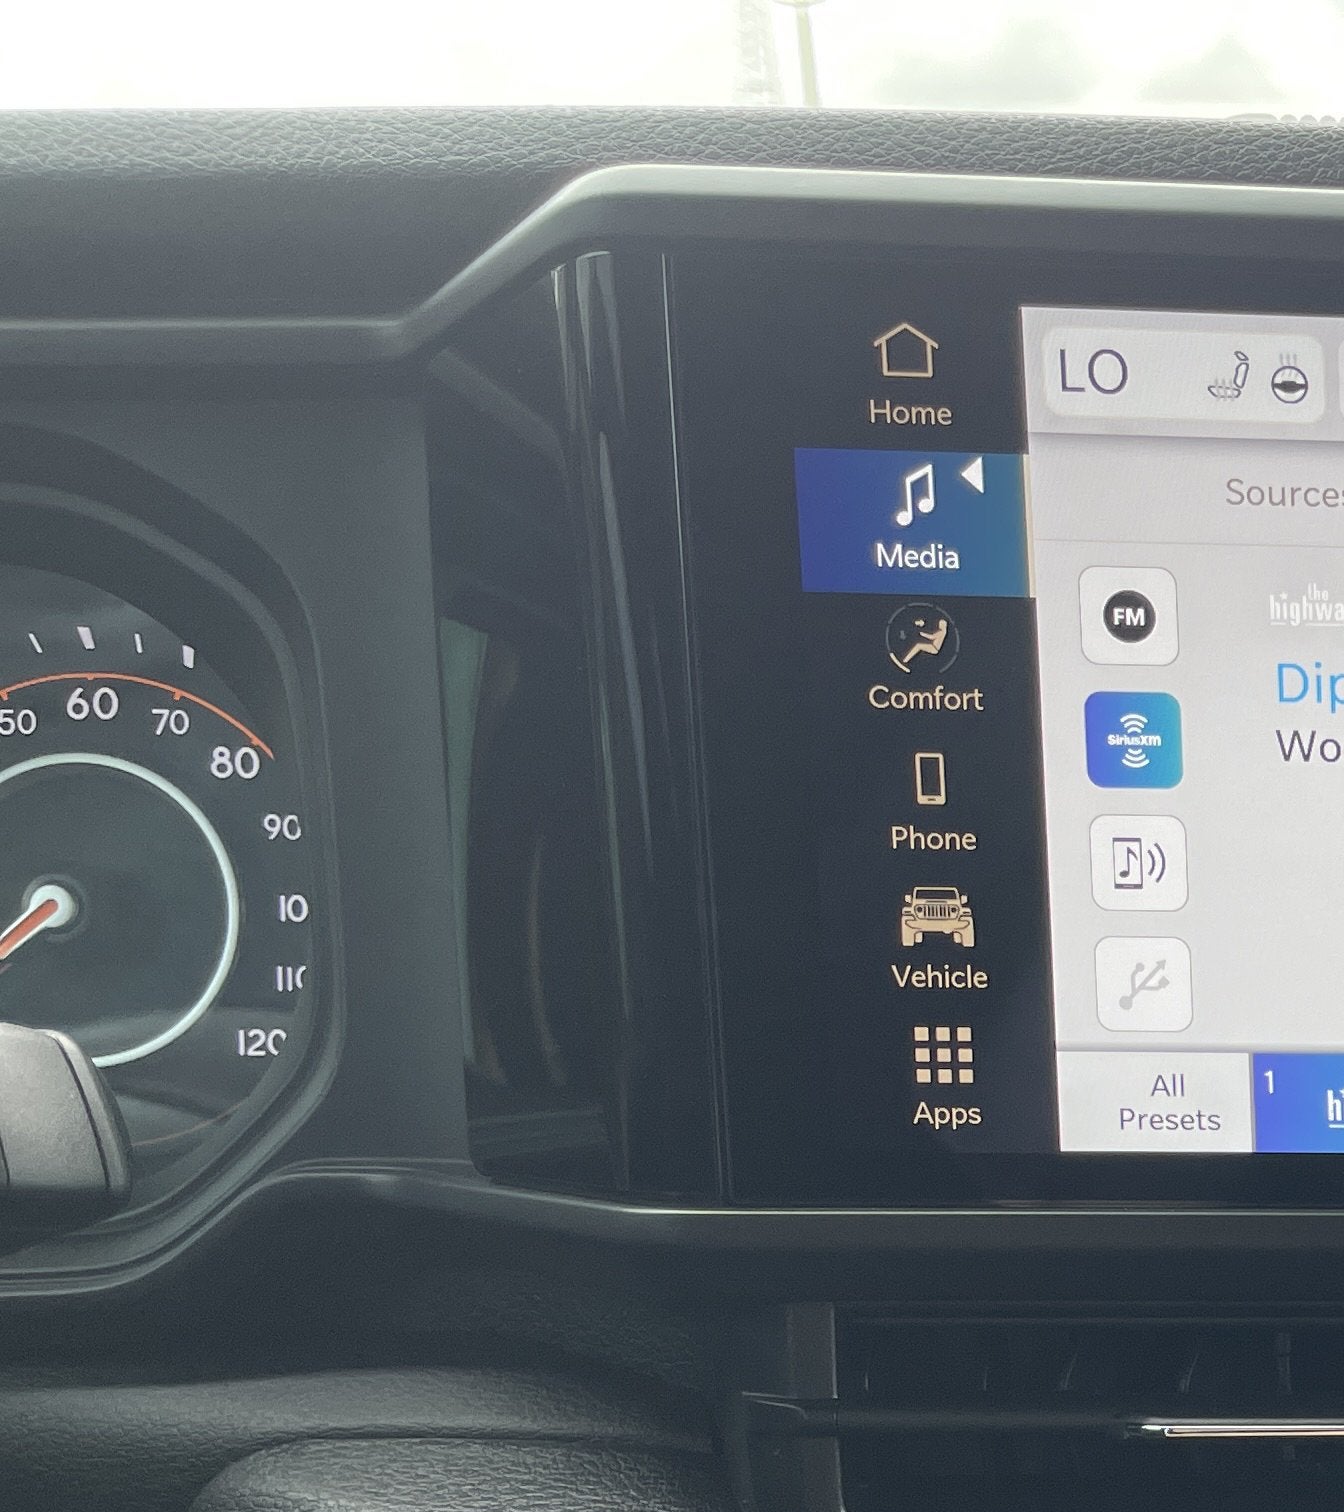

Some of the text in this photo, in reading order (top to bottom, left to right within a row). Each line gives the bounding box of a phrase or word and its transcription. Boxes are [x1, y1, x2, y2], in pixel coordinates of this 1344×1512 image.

[1060, 349, 1128, 394] LO
[869, 400, 952, 425] Home
[877, 543, 959, 569] Media
[1113, 607, 1144, 625] FM
[66, 688, 119, 721] 60
[868, 685, 984, 712] Comfort
[0, 709, 37, 736] 50
[151, 708, 189, 736] 70
[210, 746, 259, 780] 80
[263, 814, 302, 841] 90
[891, 826, 976, 854] Phone
[279, 894, 309, 923] 10
[892, 964, 988, 990] Vehicle
[1151, 1074, 1185, 1098] All
[1265, 1070, 1274, 1094] 1
[913, 1102, 981, 1130] Apps
[1119, 1107, 1221, 1133] Presets
